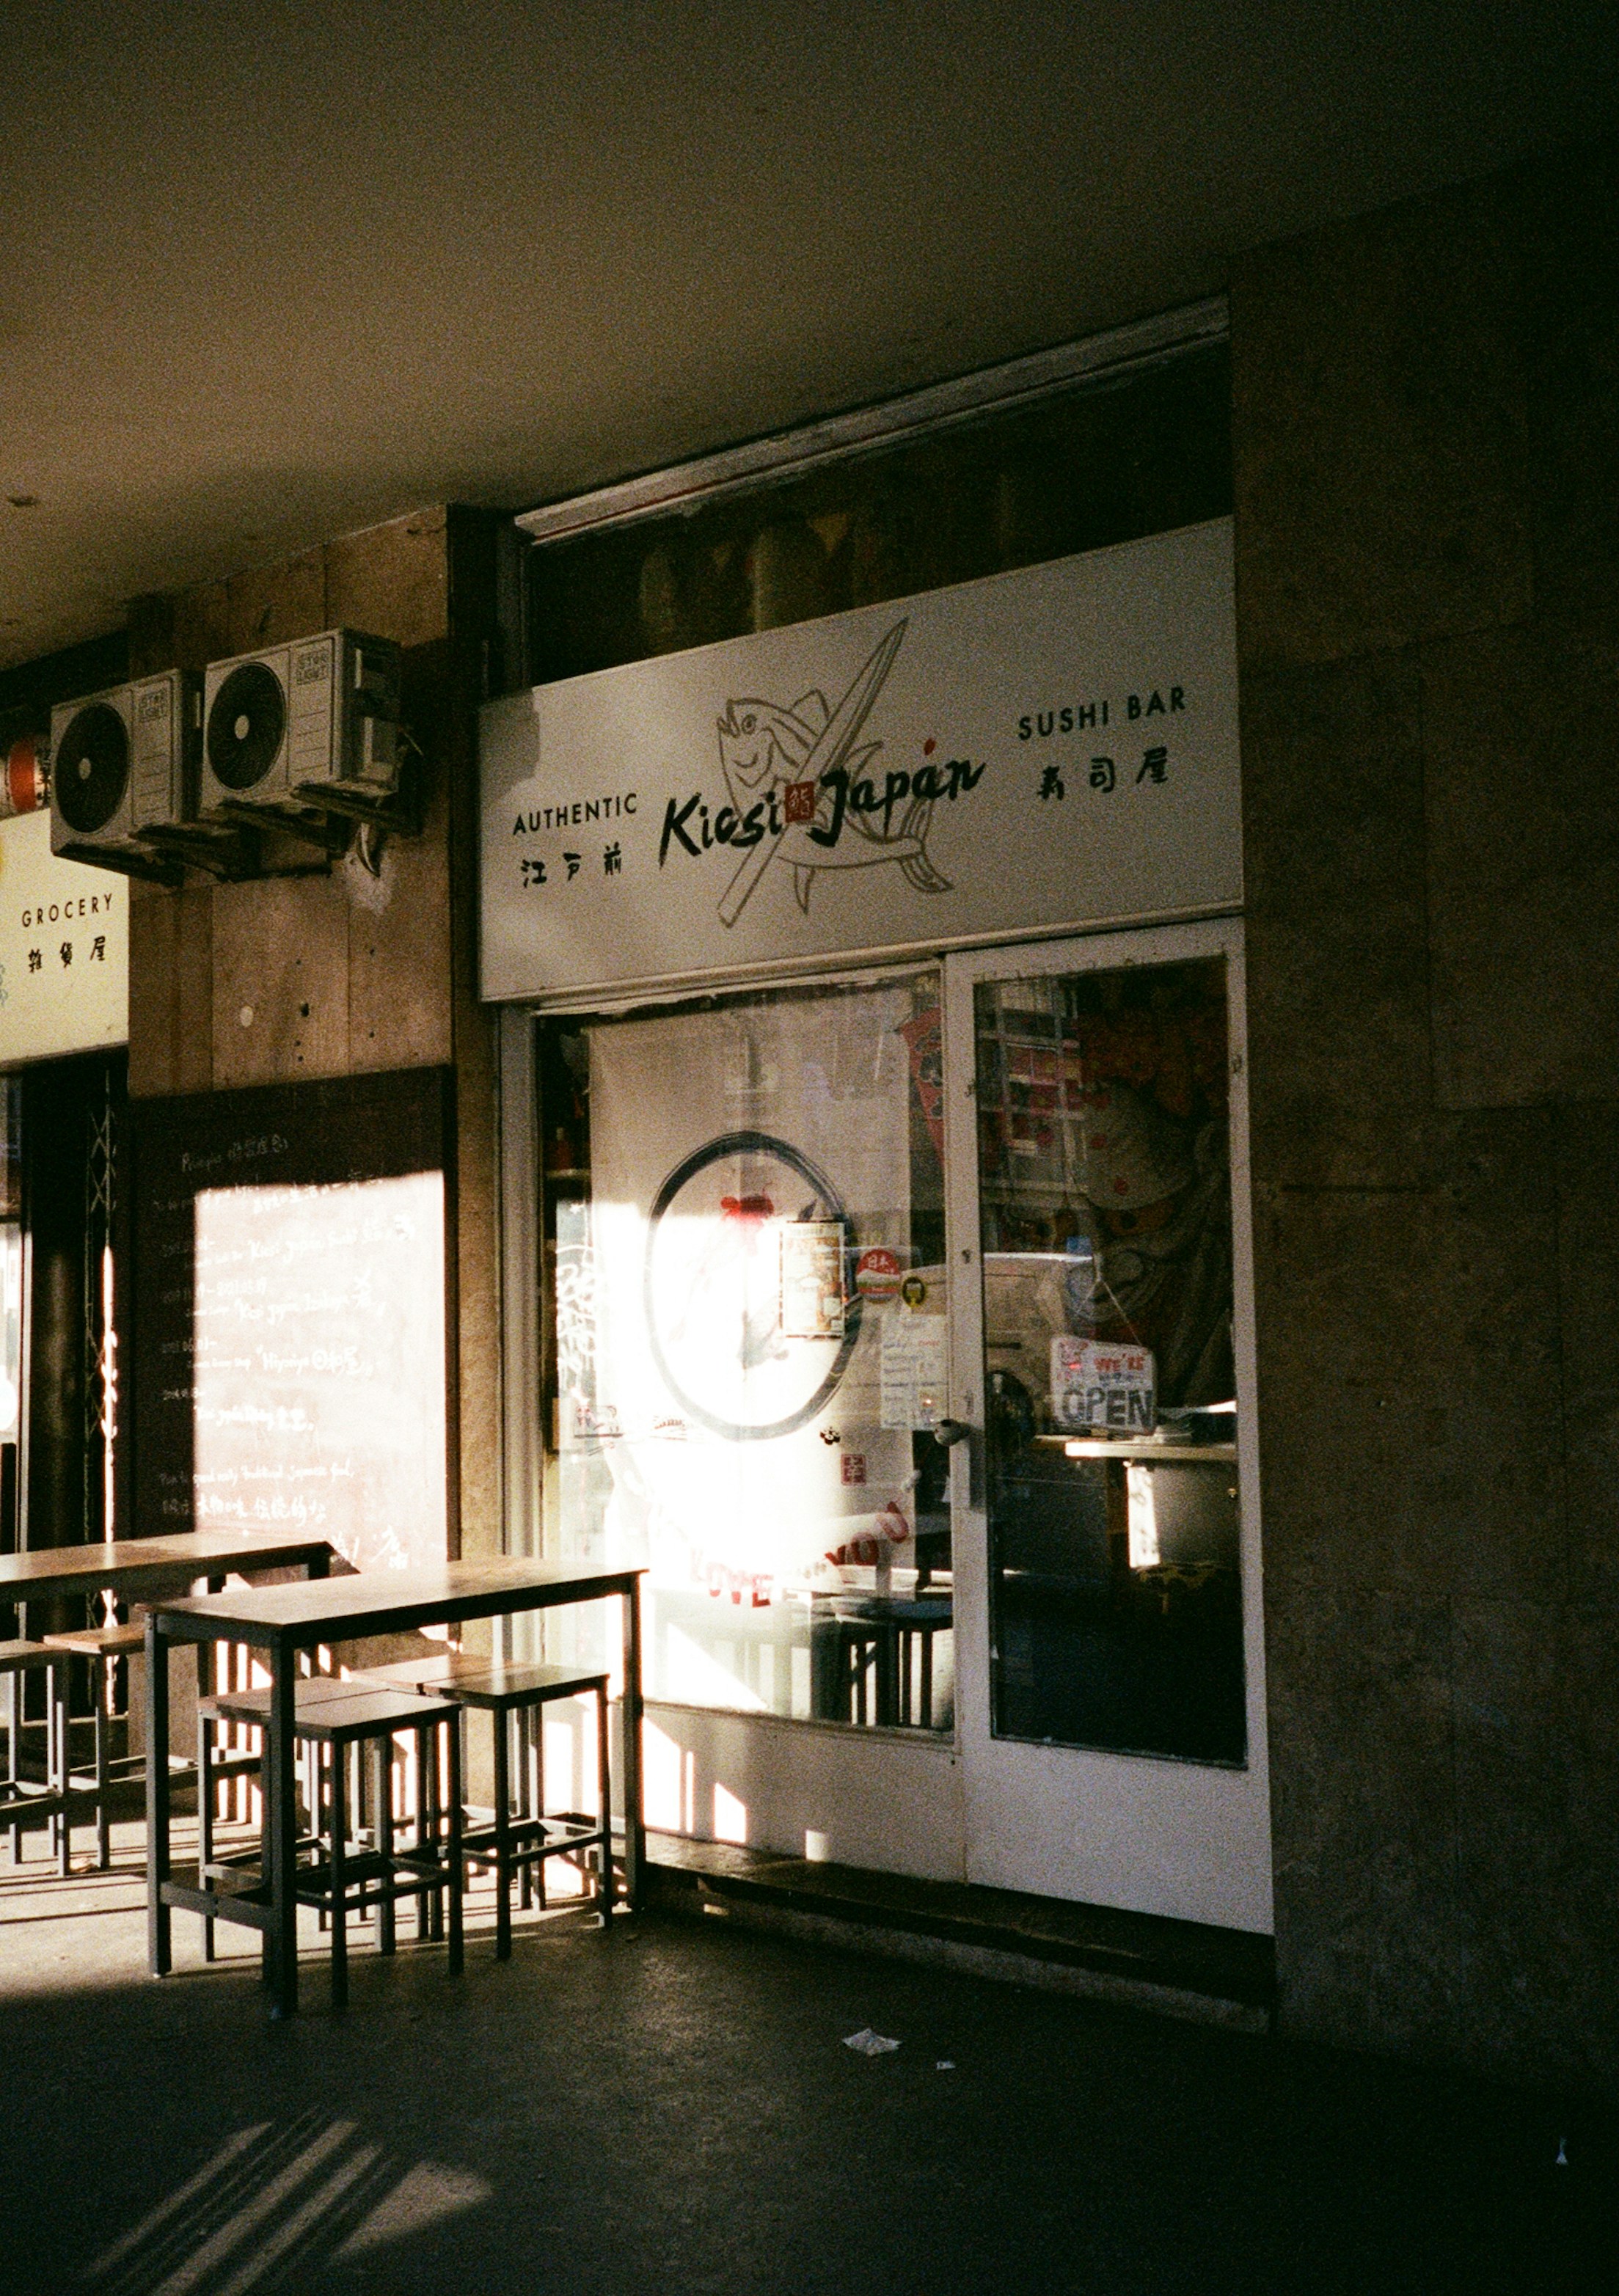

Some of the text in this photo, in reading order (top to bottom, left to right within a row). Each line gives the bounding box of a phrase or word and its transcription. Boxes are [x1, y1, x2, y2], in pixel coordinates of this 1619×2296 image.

[1018, 686, 1186, 741] SUSHI BAR
[513, 793, 637, 836] AUTHENTIC
[805, 758, 987, 847] Japan
[21, 893, 113, 928] GROCERY
[1061, 1386, 1154, 1429] OPEN
